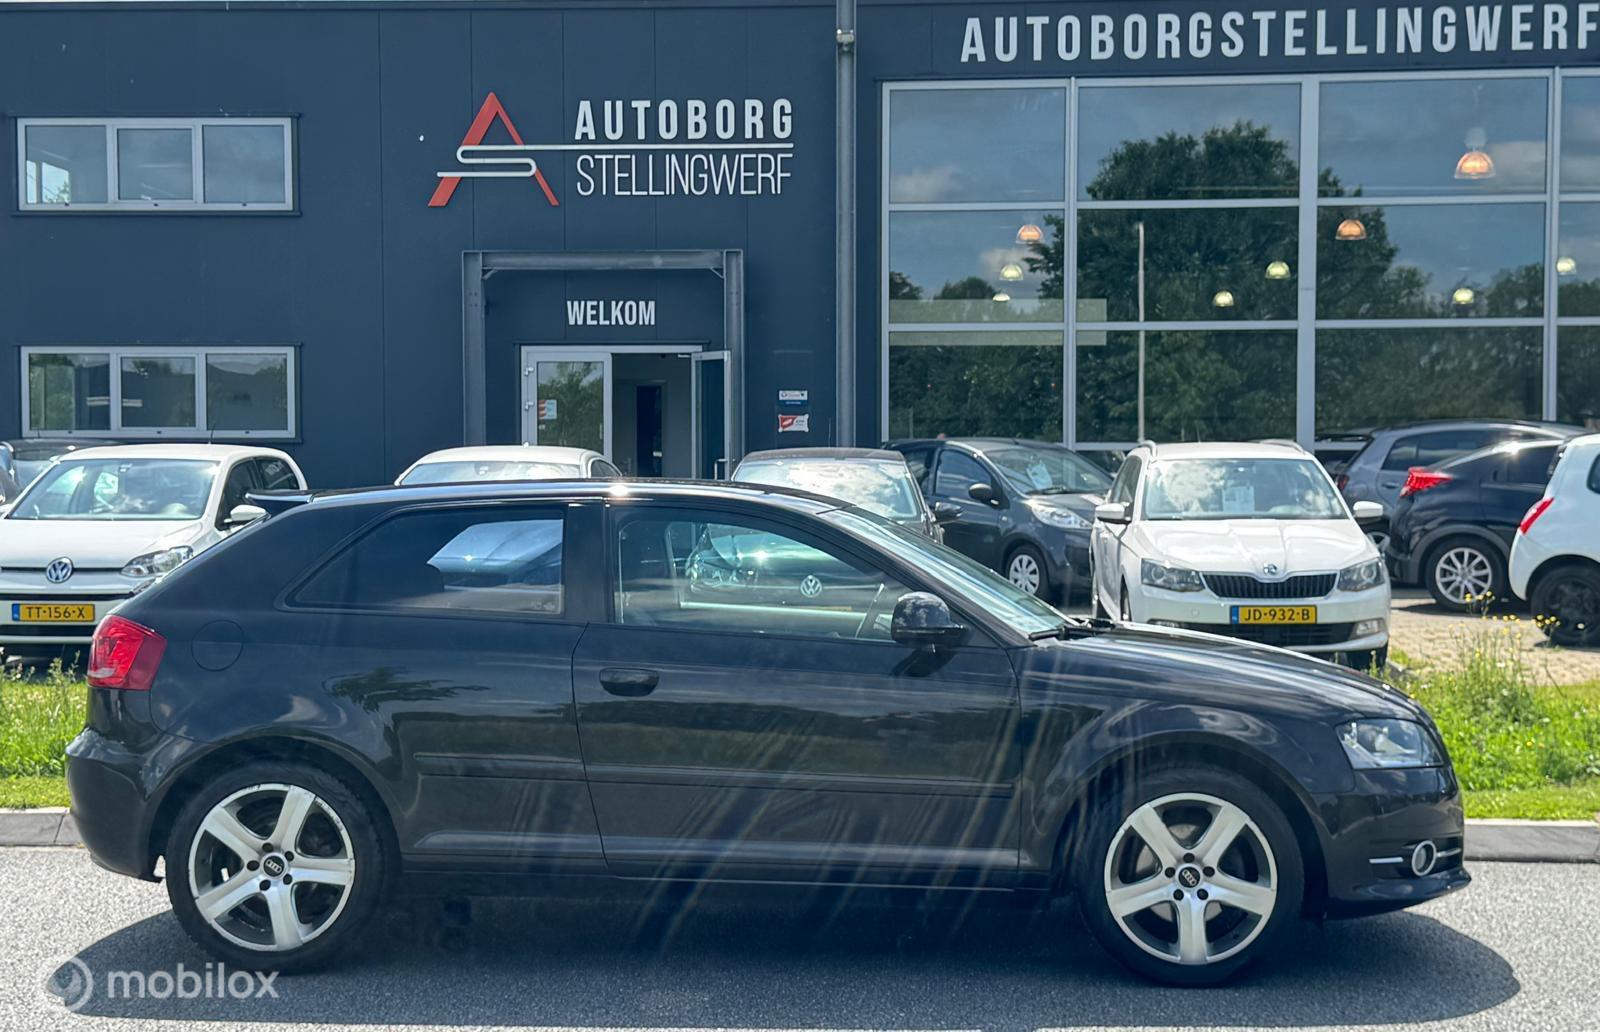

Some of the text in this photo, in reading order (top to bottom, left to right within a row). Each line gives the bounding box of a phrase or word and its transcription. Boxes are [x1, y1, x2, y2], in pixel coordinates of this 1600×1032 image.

[960, 3, 1600, 63] AUTOBORGSTELLINGWERF
[574, 98, 793, 140] AUTOBORG
[576, 153, 793, 196] STELLINGWERF
[566, 299, 656, 326] WELKOM
[26, 606, 86, 619] TT-156-X
[1243, 608, 1311, 622] JD-932-B
